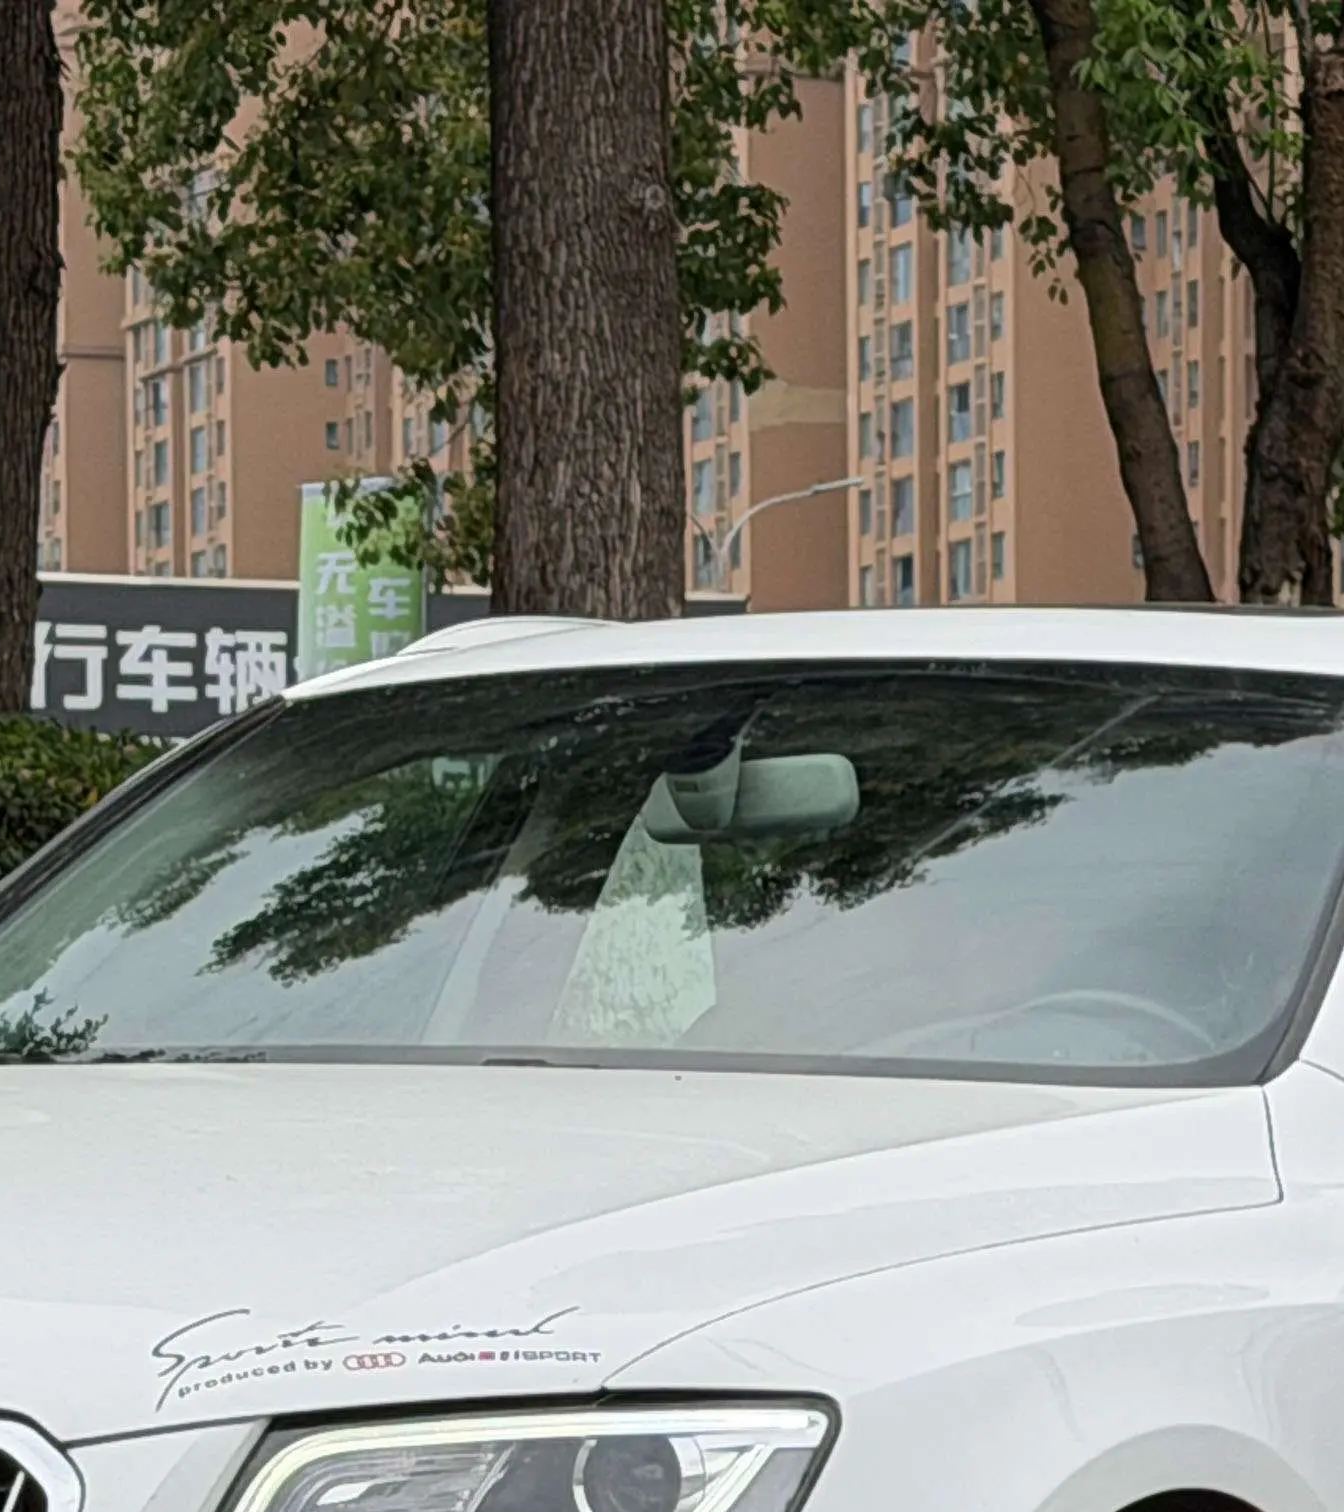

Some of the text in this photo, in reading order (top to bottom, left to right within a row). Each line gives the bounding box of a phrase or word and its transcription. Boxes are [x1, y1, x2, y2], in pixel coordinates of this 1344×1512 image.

[315, 551, 358, 674] 无溢
[178, 1360, 297, 1398] produced
[304, 1358, 333, 1373] by
